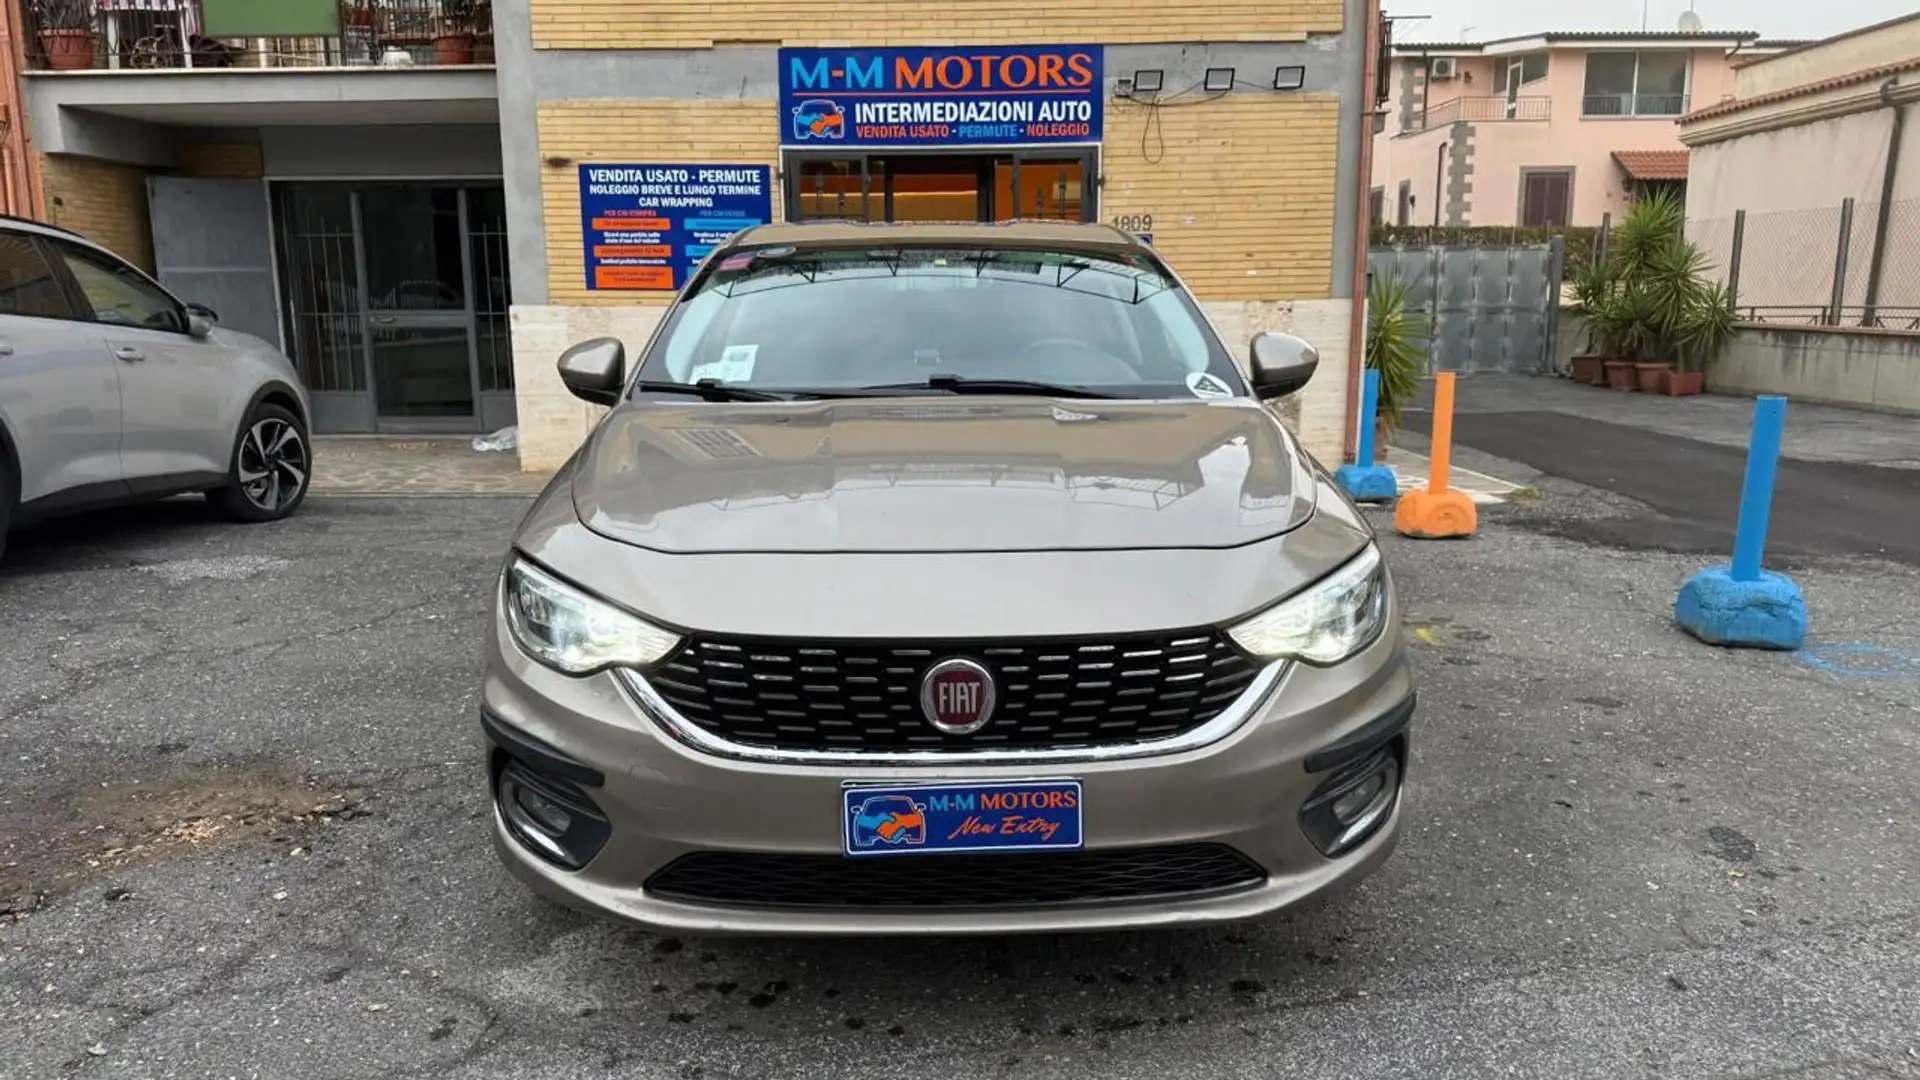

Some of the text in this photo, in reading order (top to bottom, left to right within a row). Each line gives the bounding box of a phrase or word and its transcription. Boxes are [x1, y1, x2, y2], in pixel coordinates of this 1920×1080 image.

[791, 53, 1093, 89] M-M MOTORS
[855, 100, 1092, 123] INTERMEDIAZIONI AUTO
[856, 123, 1090, 139] VENDITA USATO PERMUTE NOLEGGIO
[589, 169, 761, 183] VENDITA USATO PERMUTE
[589, 184, 761, 195] NOLEGGIO BREVE E LUNGO TERMINE
[638, 197, 713, 208] CAR WRAPPING
[1113, 214, 1153, 232] 1809
[938, 682, 981, 714] FIAT
[929, 791, 1077, 813] M-M MOTORS
[948, 816, 1061, 841] New Entry
